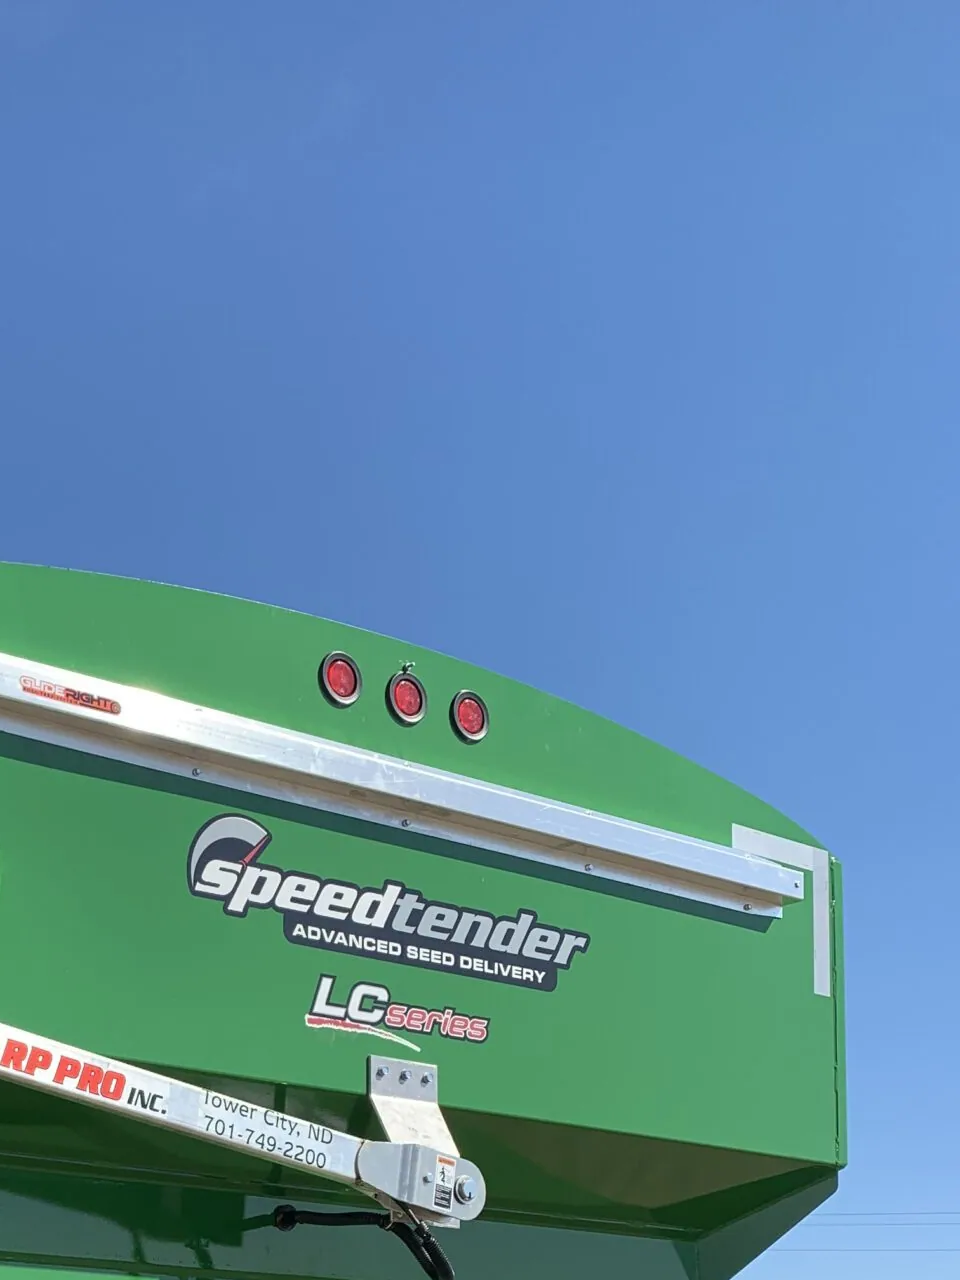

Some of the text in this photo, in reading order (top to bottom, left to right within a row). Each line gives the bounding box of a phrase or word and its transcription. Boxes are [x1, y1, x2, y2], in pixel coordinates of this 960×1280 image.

[292, 923, 546, 983] ADVANCED SEED DELIVERY
[53, 1054, 127, 1101] PRO
[127, 1086, 168, 1115] INC.
[203, 1088, 334, 1145] Tower City, ND
[203, 1115, 327, 1169] 701-749-2200
